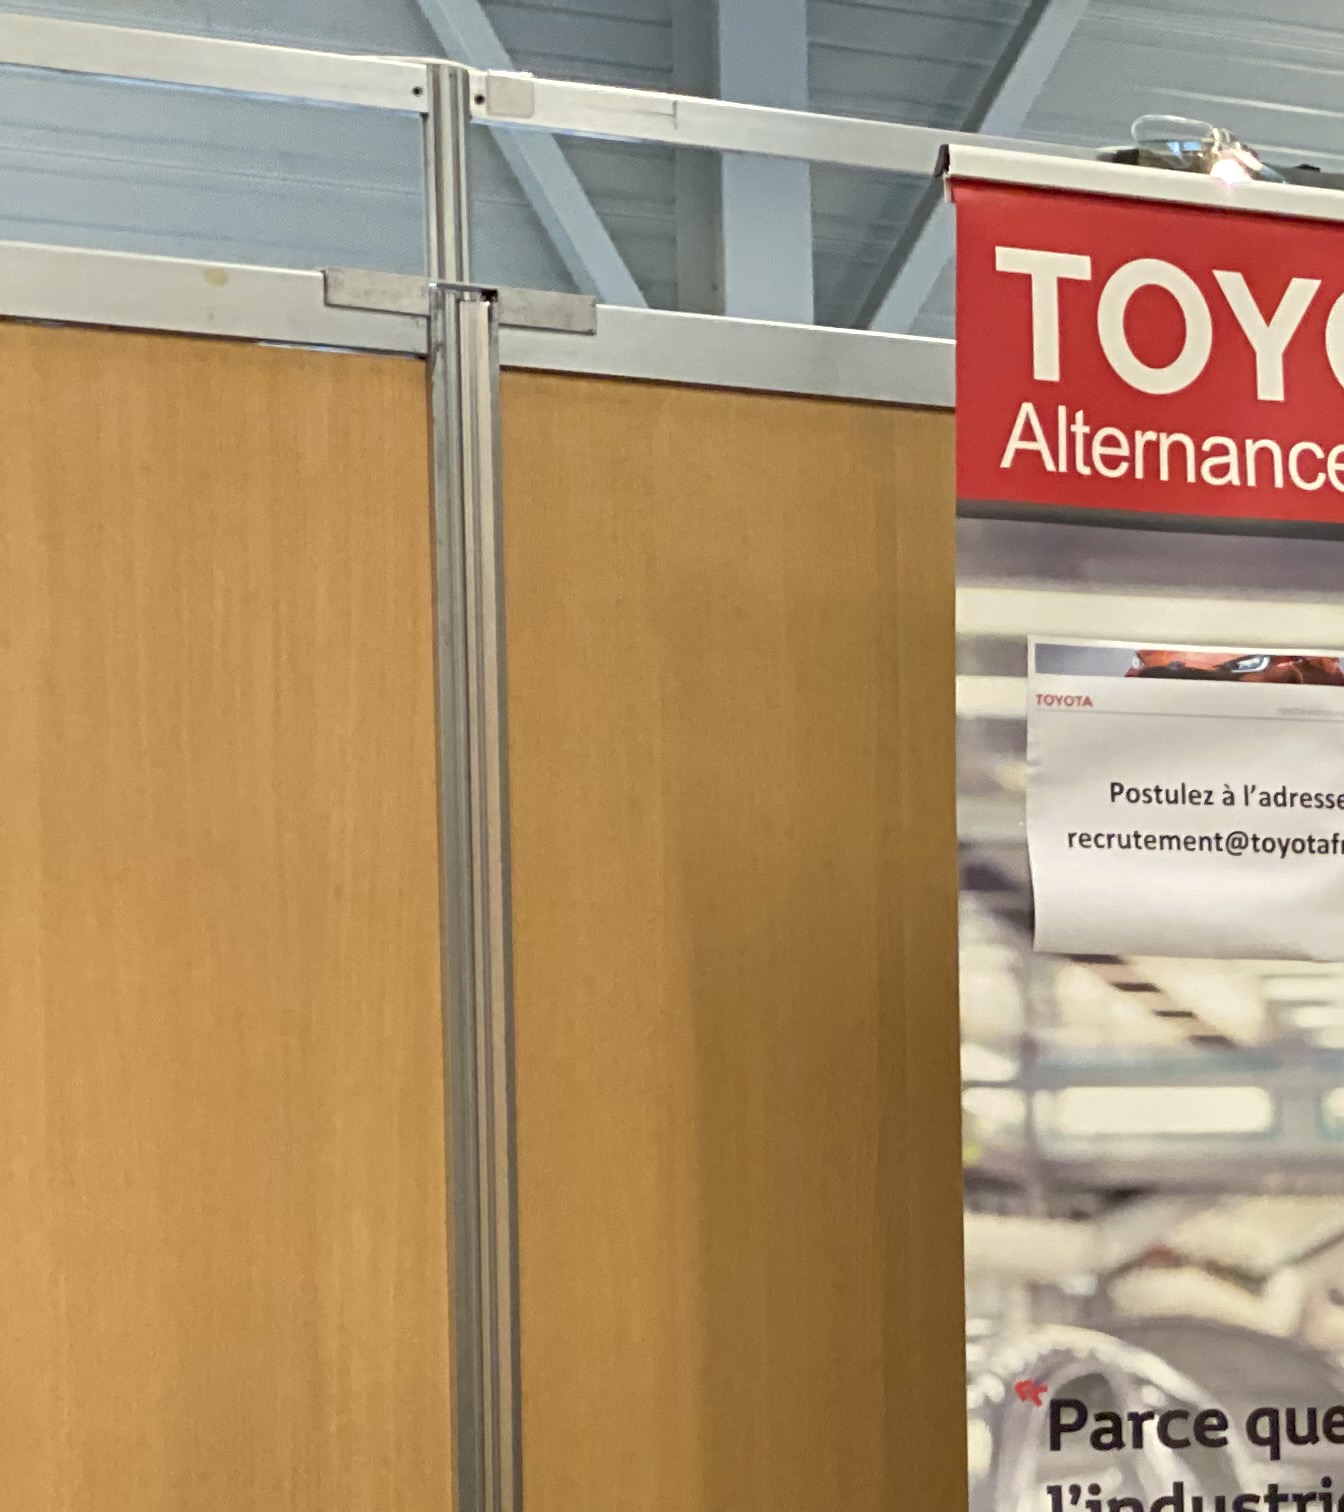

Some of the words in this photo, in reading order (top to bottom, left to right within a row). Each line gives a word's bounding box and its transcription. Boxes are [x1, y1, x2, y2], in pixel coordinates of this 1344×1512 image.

[1036, 693, 1093, 707] TOYOTA
[1110, 782, 1214, 806] Postulez
[1222, 783, 1235, 806] à
